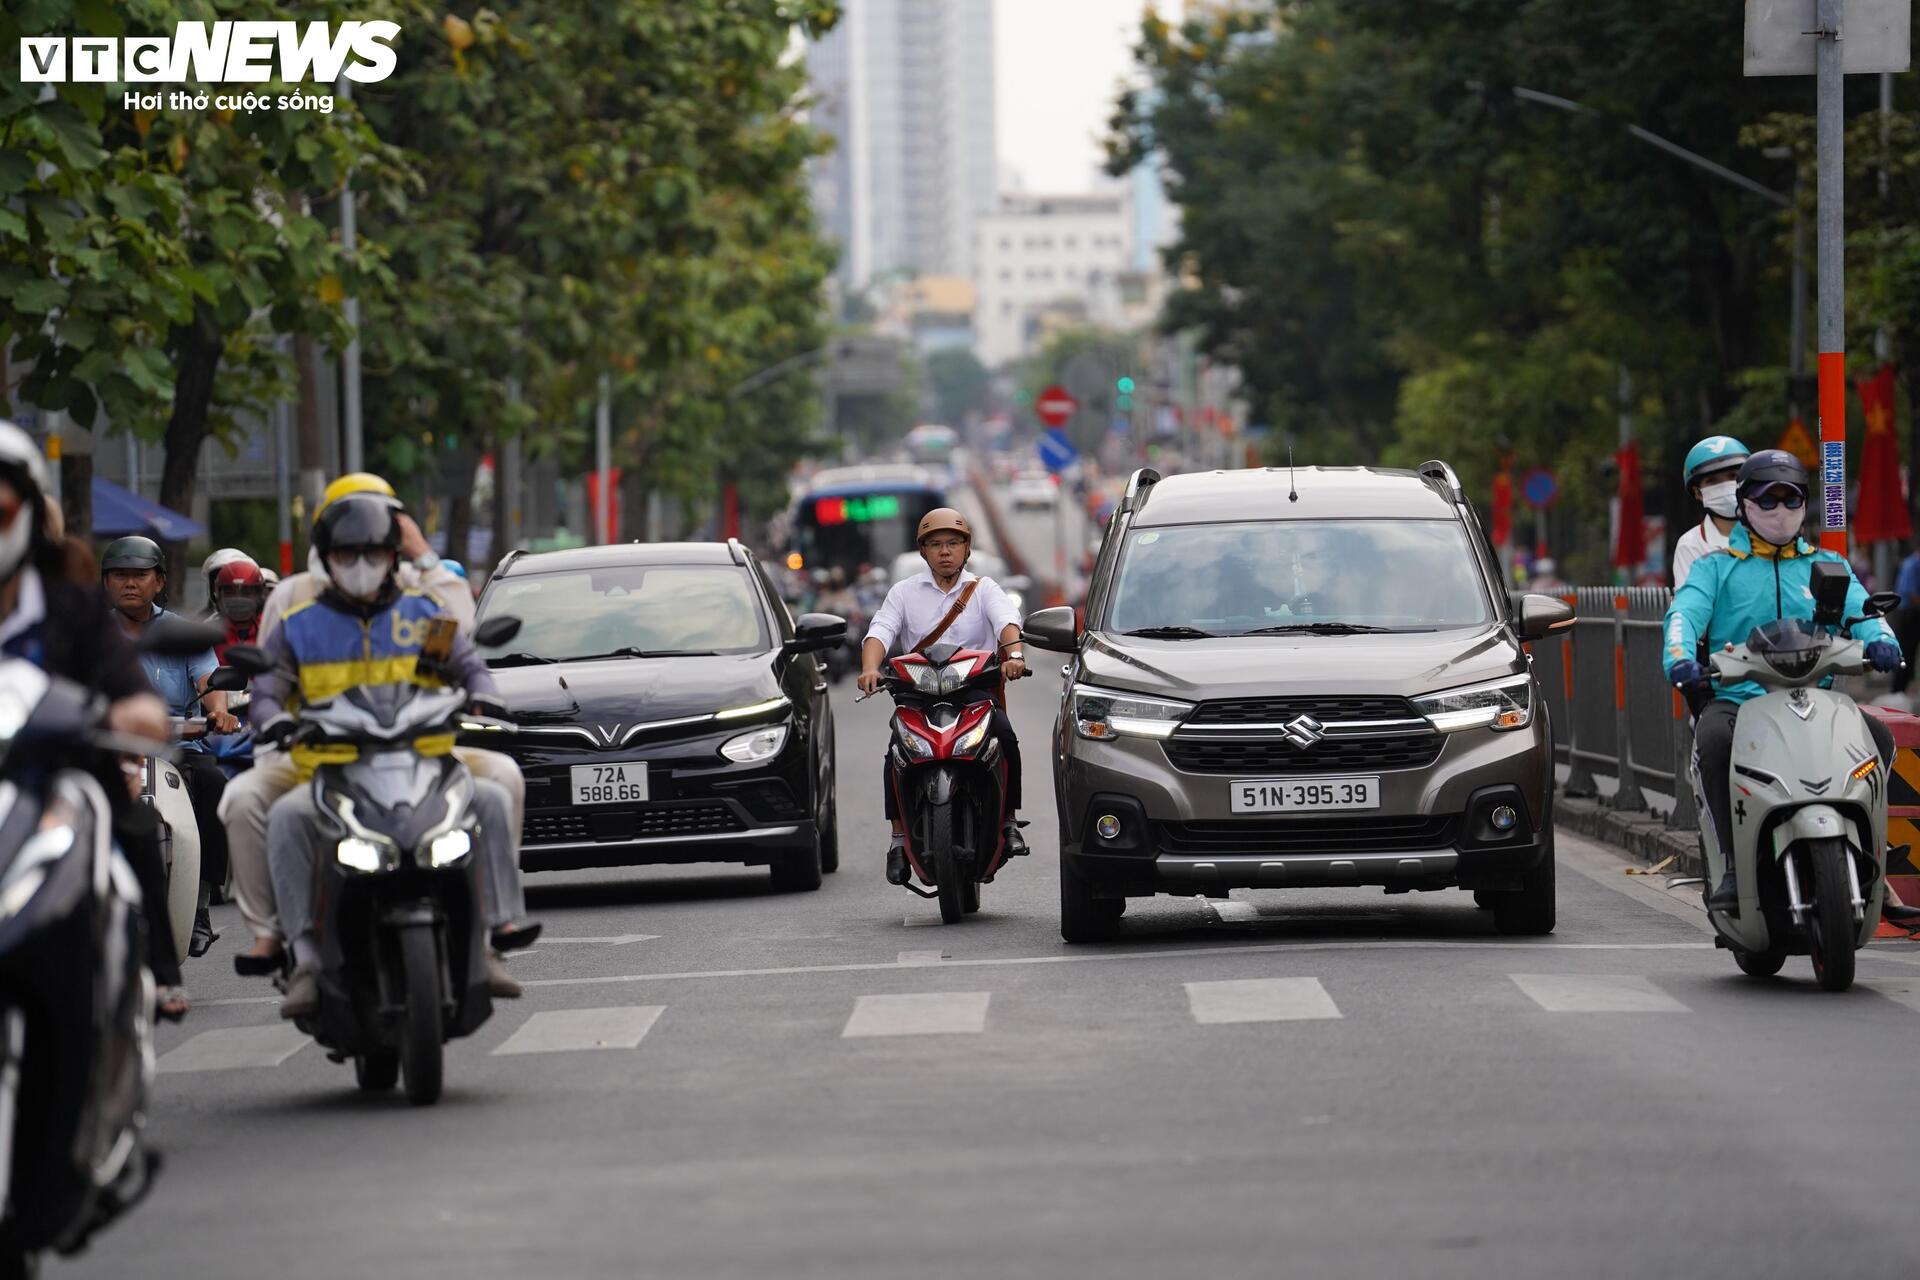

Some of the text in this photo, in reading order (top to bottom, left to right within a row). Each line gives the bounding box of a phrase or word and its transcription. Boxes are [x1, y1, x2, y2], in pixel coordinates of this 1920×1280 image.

[593, 767, 625, 783] 72A
[580, 784, 640, 802] 588.66
[1243, 784, 1367, 807] 51N-395.39
